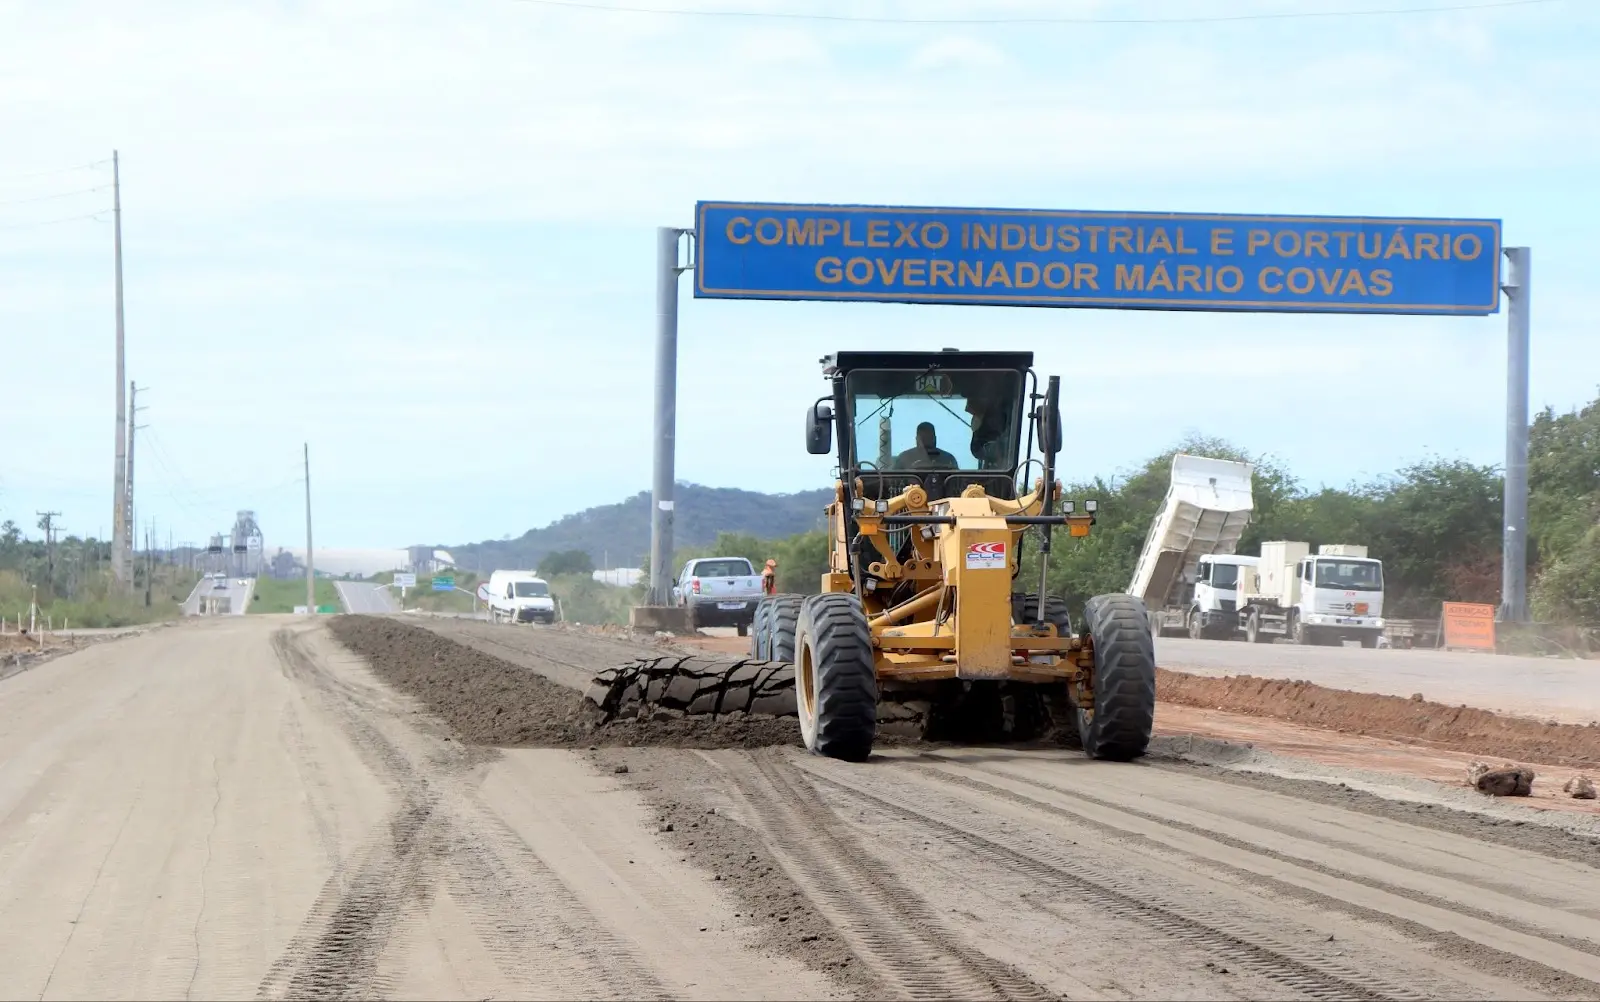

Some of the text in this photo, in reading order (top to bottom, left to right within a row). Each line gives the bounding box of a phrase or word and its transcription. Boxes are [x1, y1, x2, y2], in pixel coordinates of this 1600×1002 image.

[725, 216, 1483, 261] COMPLEXO INDUSTRIAL E PORTUÁRIO
[814, 255, 1393, 297] GOVERNADOR MÁRIO COVAS
[915, 375, 943, 392] CAT
